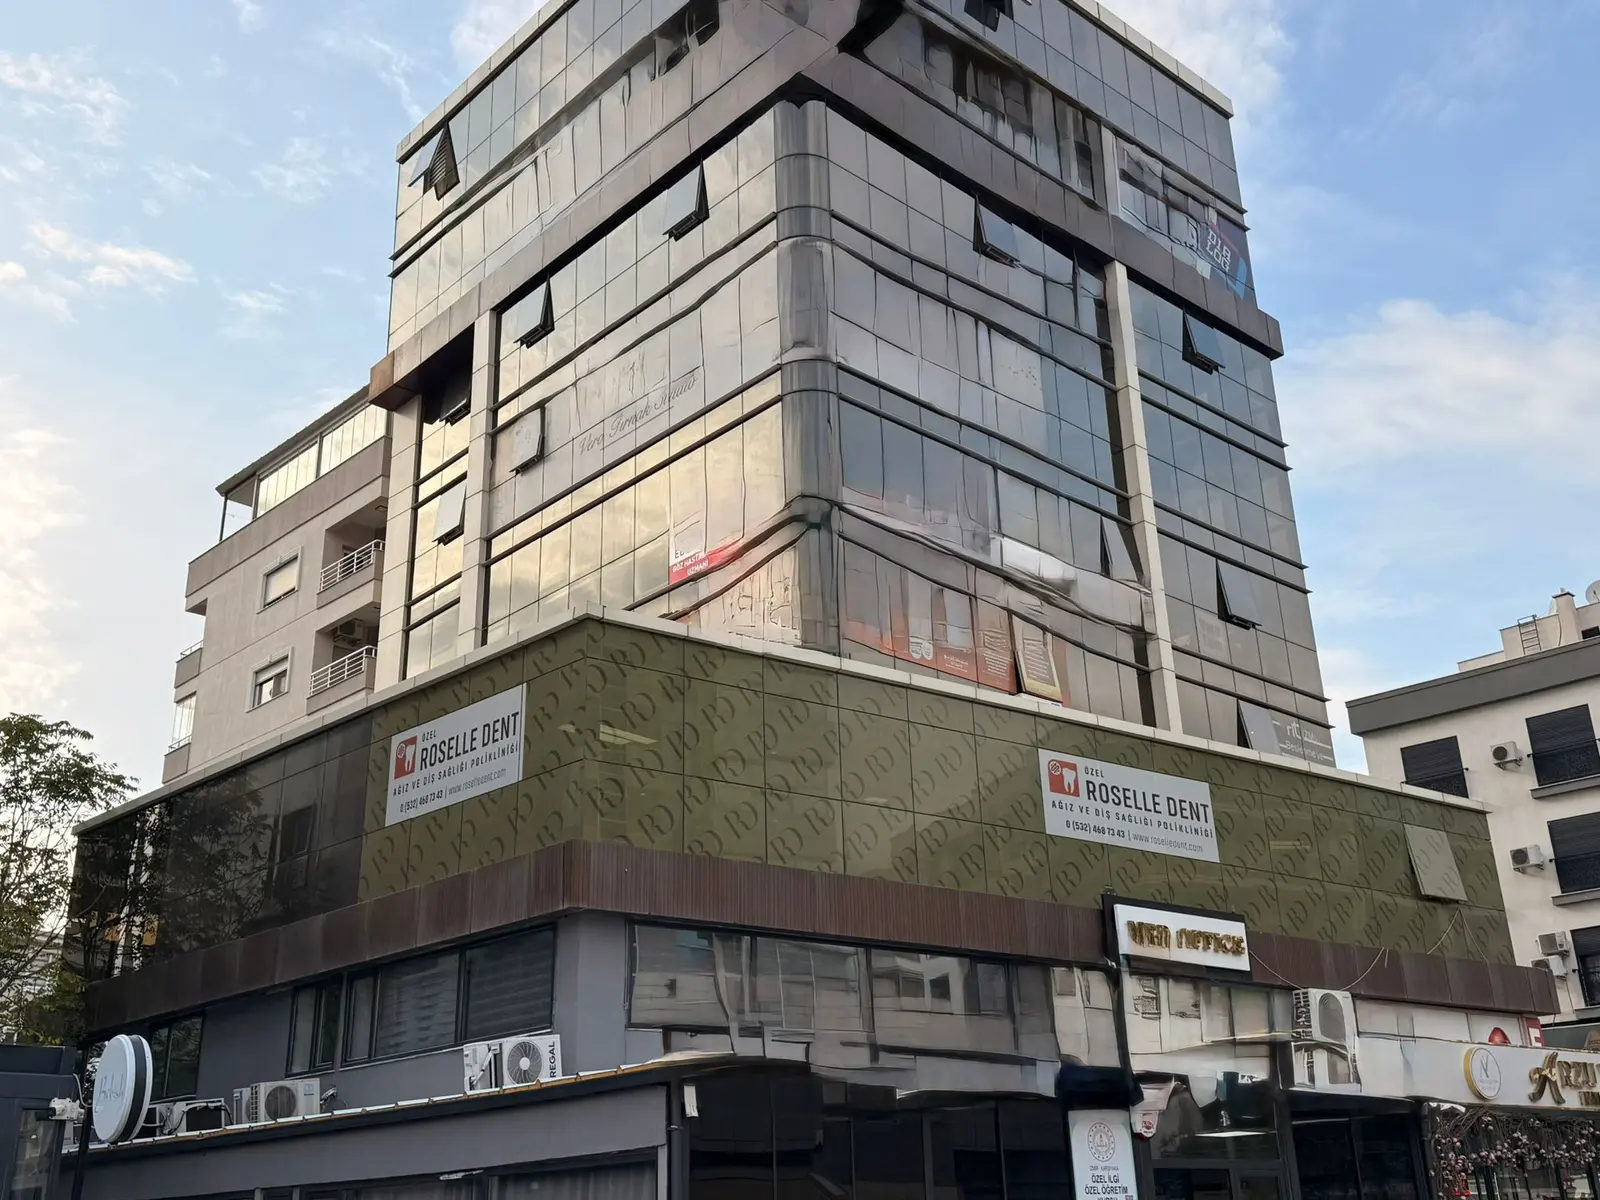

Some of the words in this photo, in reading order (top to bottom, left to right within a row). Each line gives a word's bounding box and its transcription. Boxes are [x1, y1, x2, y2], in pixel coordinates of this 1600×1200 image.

[420, 727, 478, 771] ROSELLE
[482, 711, 520, 748] DENT
[393, 783, 409, 797] AĞIZ
[412, 778, 420, 789] VE
[423, 774, 435, 786] DİŞ
[438, 762, 468, 780] SAĞLIĞI
[1084, 766, 1105, 778] ÖZEL
[1051, 800, 1074, 812] AĞIZ
[1078, 805, 1090, 815] VE
[1094, 808, 1111, 819] DİŞ
[1115, 812, 1153, 827] SAĞLIĞI
[1157, 820, 1213, 839] POLİKLİNİĞİ
[1085, 780, 1162, 815] ROSELLE
[1167, 796, 1209, 824] DENT
[1065, 820, 1071, 829] 0
[1072, 821, 1091, 834] (532)
[1092, 824, 1107, 835] 468
[1107, 826, 1116, 837] 73
[1116, 828, 1126, 838] 43
[1132, 832, 1204, 853] www.roselledent.com
[548, 1041, 557, 1079] REGAL
[1085, 1184, 1101, 1195] ÖZEL
[1091, 1173, 1107, 1184] ÖZEL
